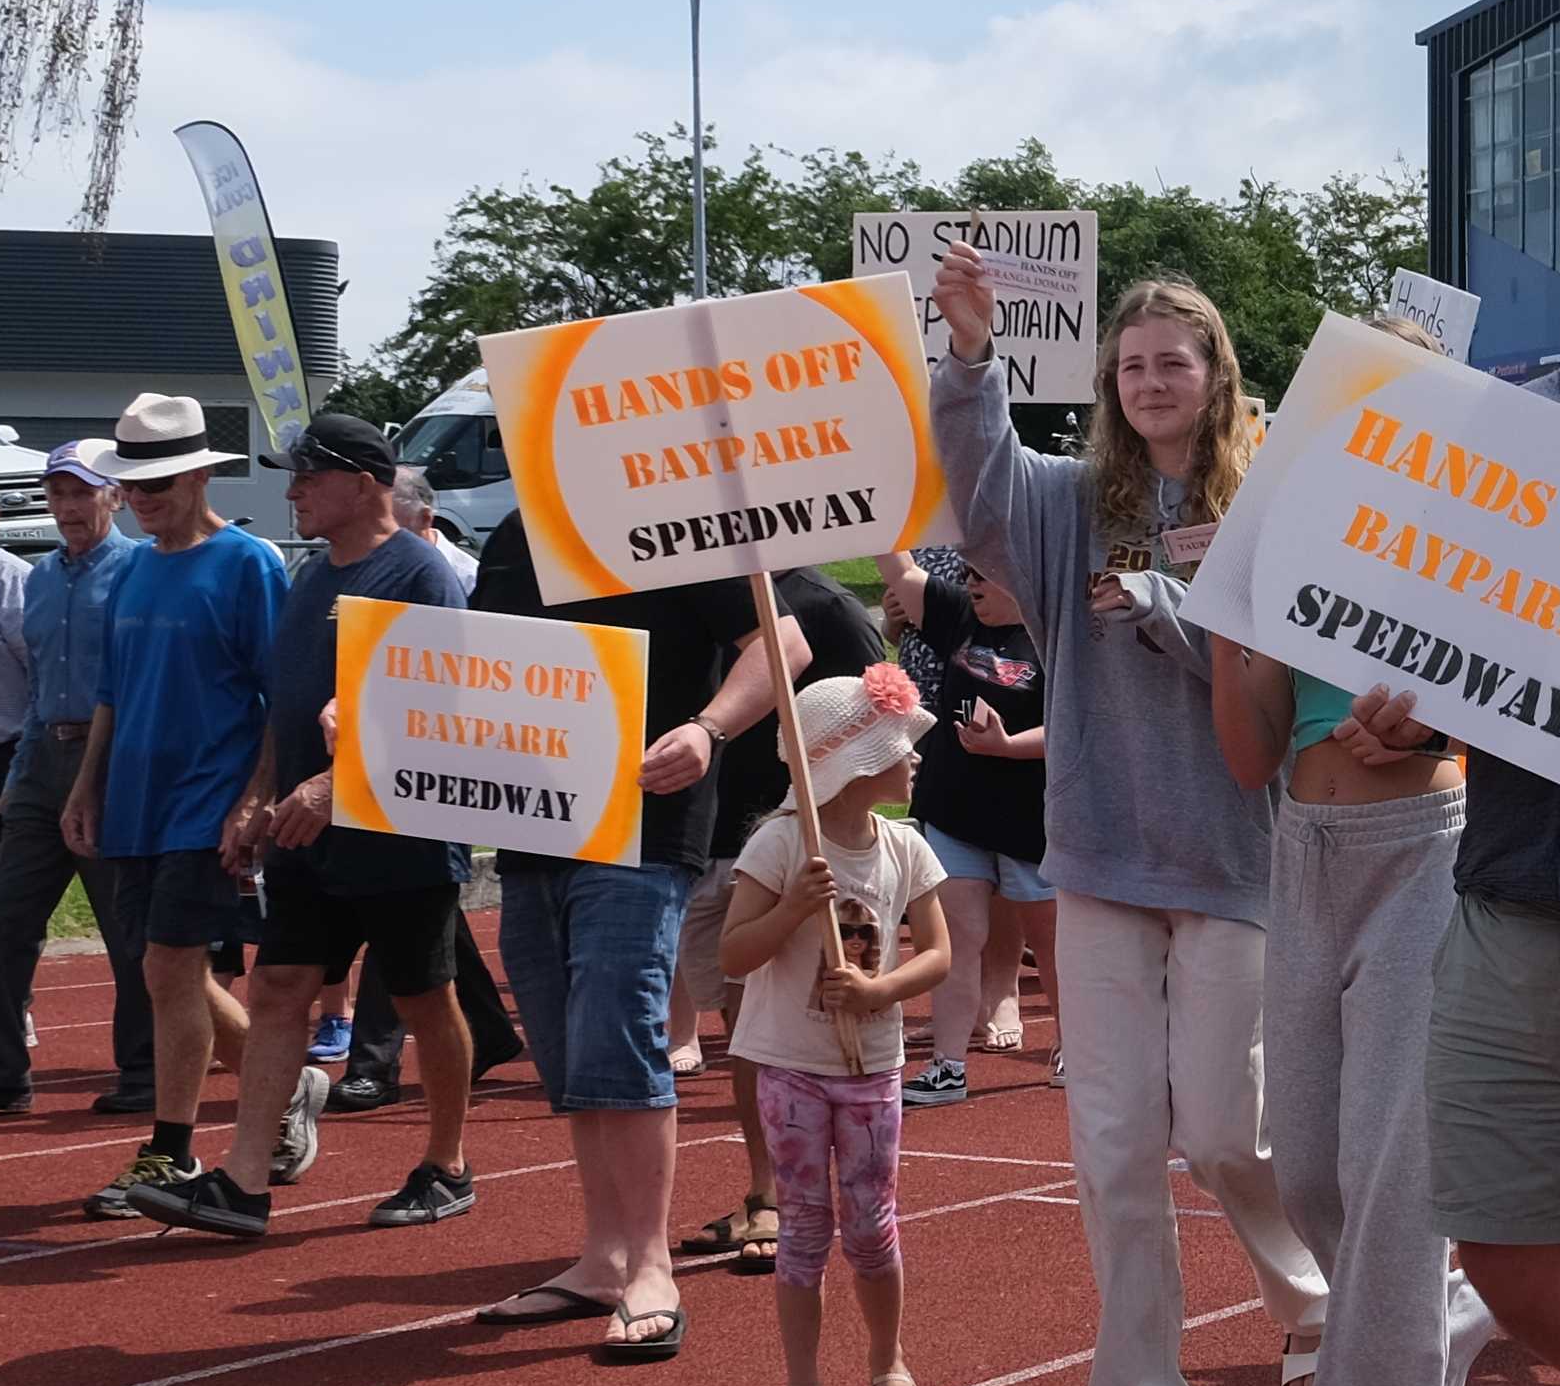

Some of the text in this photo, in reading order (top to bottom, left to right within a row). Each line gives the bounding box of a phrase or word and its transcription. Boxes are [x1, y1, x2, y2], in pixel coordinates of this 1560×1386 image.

[860, 220, 1080, 264] NO STADIUM
[1021, 261, 1056, 276] HANDS
[1034, 278, 1077, 293] DOMAIN
[991, 299, 1083, 342] OMAIN
[570, 360, 752, 427] HANDS
[764, 340, 864, 393] OFF
[622, 417, 854, 490] BAYPARK
[1344, 408, 1556, 528] HANDS
[628, 486, 877, 562] SPEEDWAY
[385, 645, 597, 703] HANDS OFF
[406, 709, 569, 759] BAYPARK
[394, 770, 577, 822] SPEEDWAY
